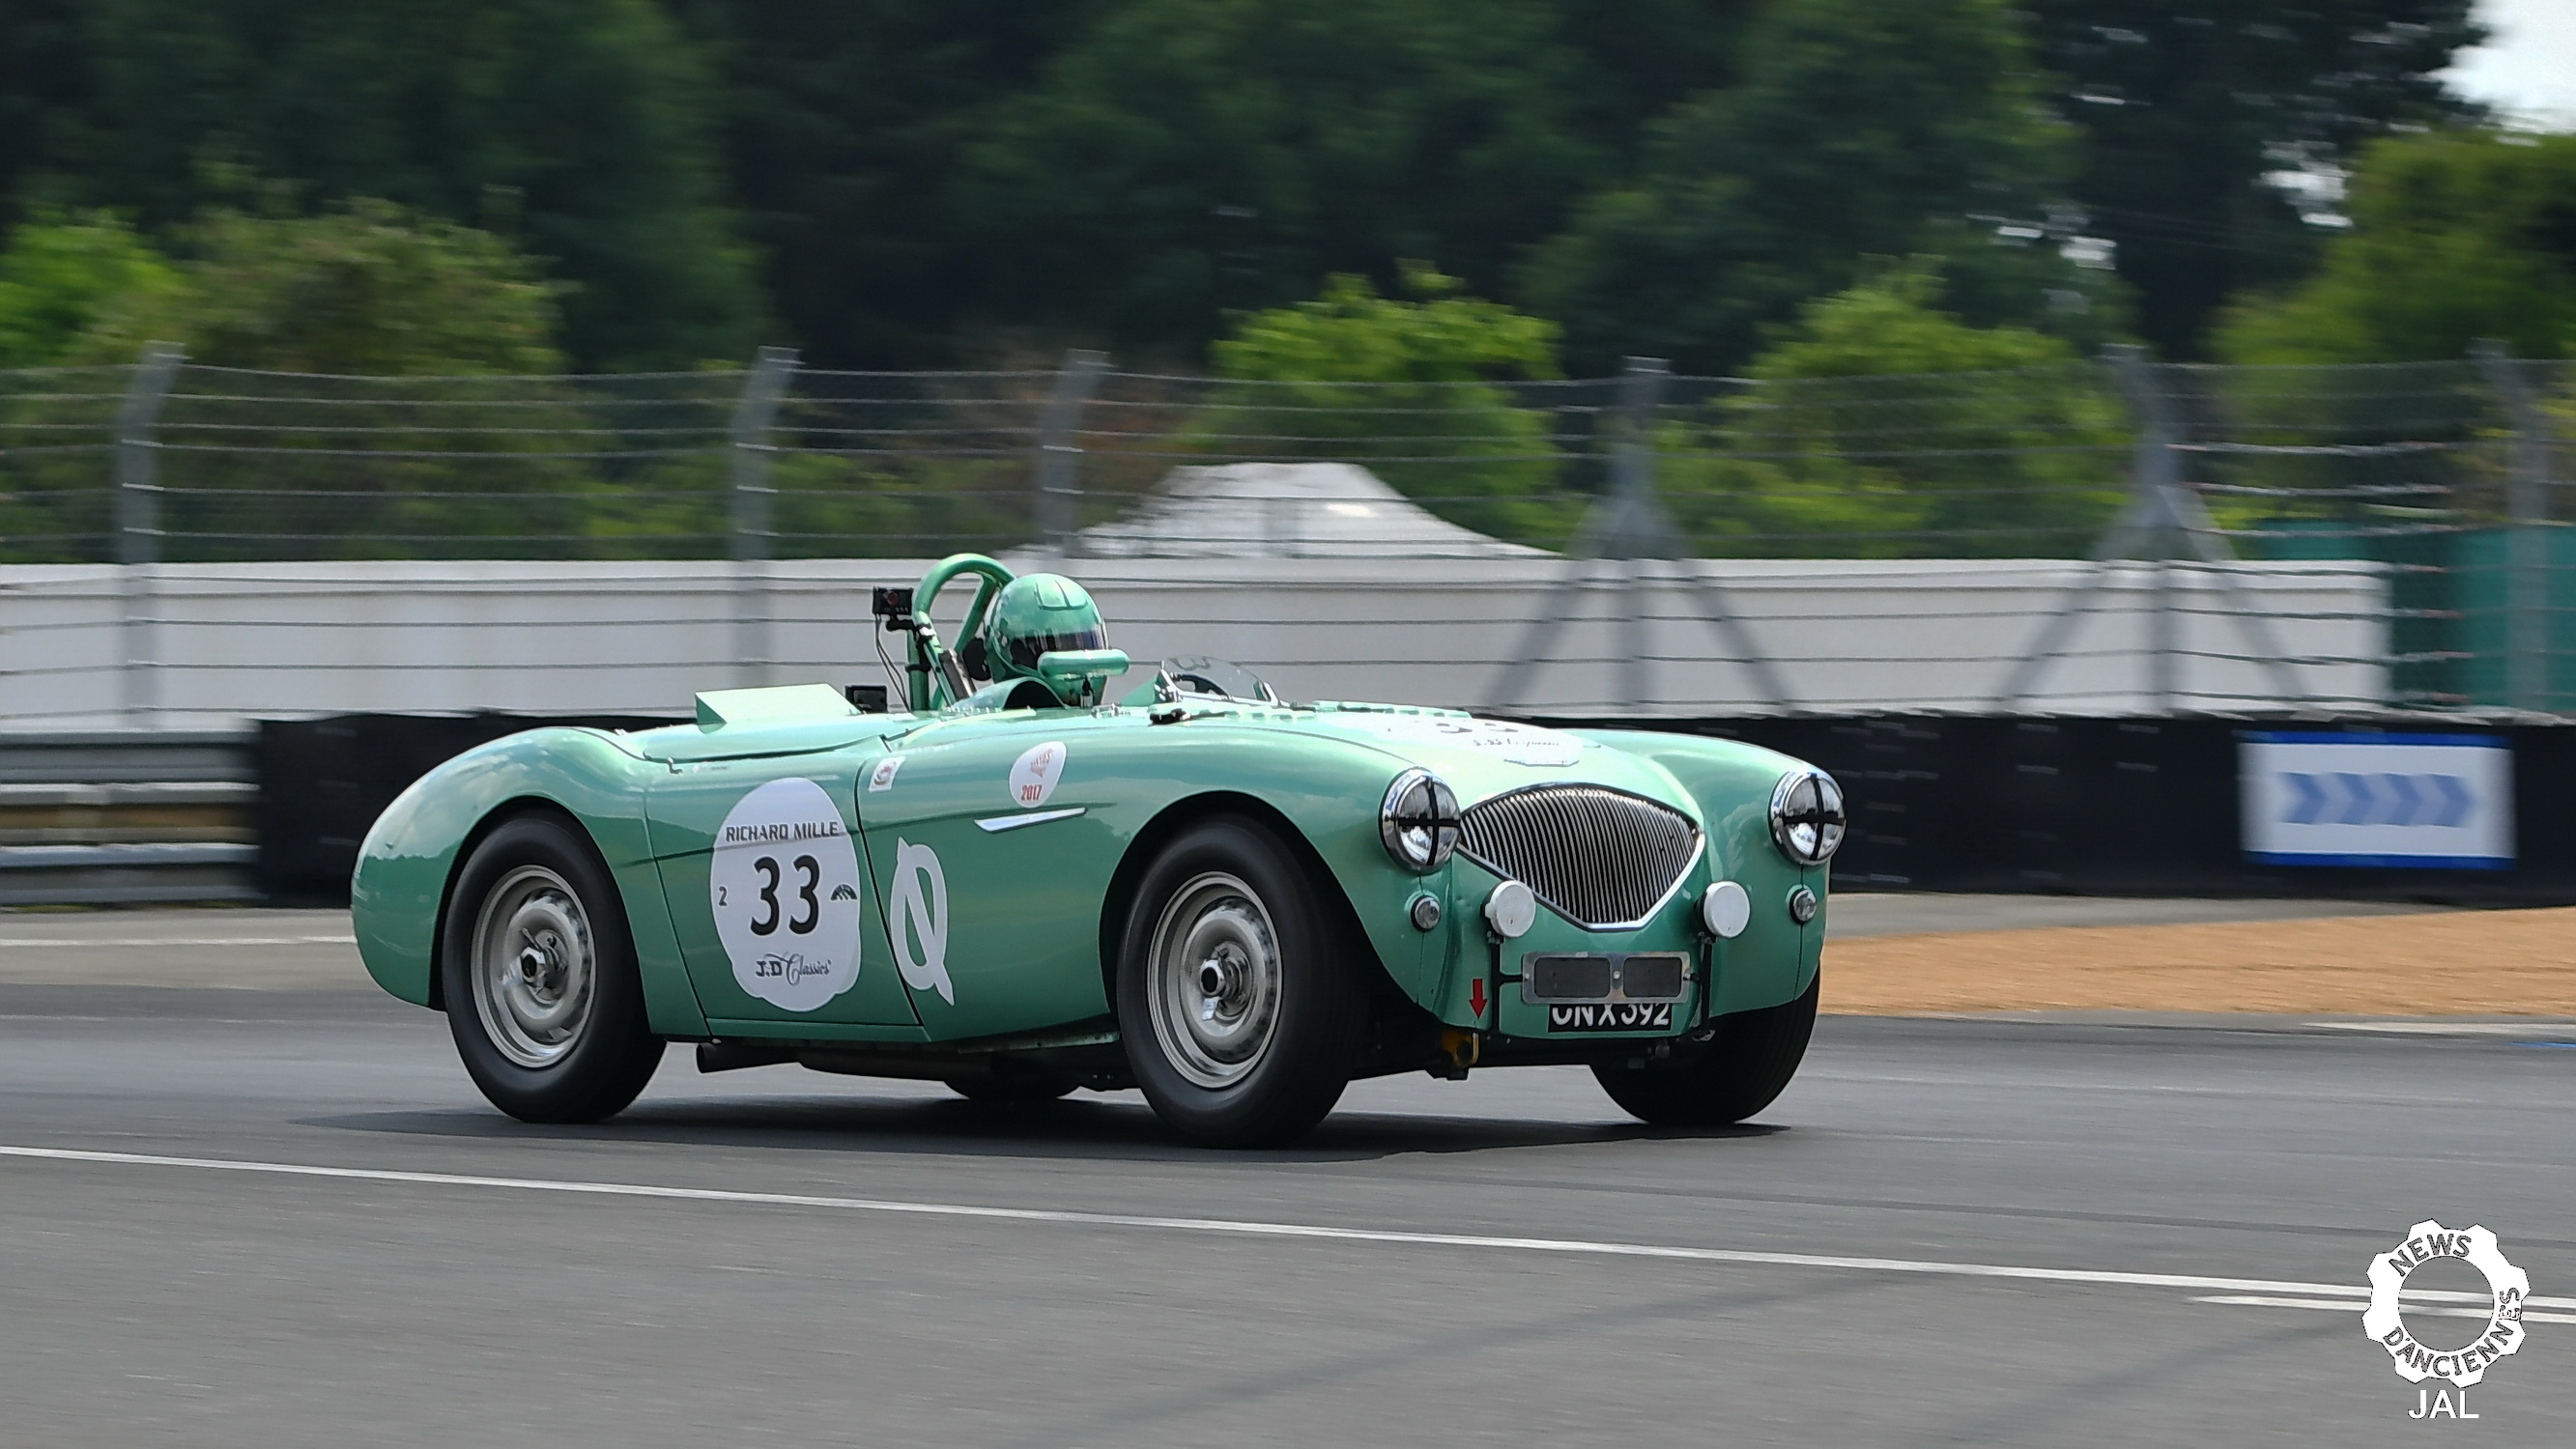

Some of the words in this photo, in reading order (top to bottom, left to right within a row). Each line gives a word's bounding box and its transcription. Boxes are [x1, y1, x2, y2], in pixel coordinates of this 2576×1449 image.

[1020, 783, 1044, 802] 2017
[725, 823, 789, 843] RICHARD
[793, 820, 840, 840] MILLE
[717, 885, 729, 907] 2
[750, 854, 821, 937] 33
[755, 960, 783, 978] J.D
